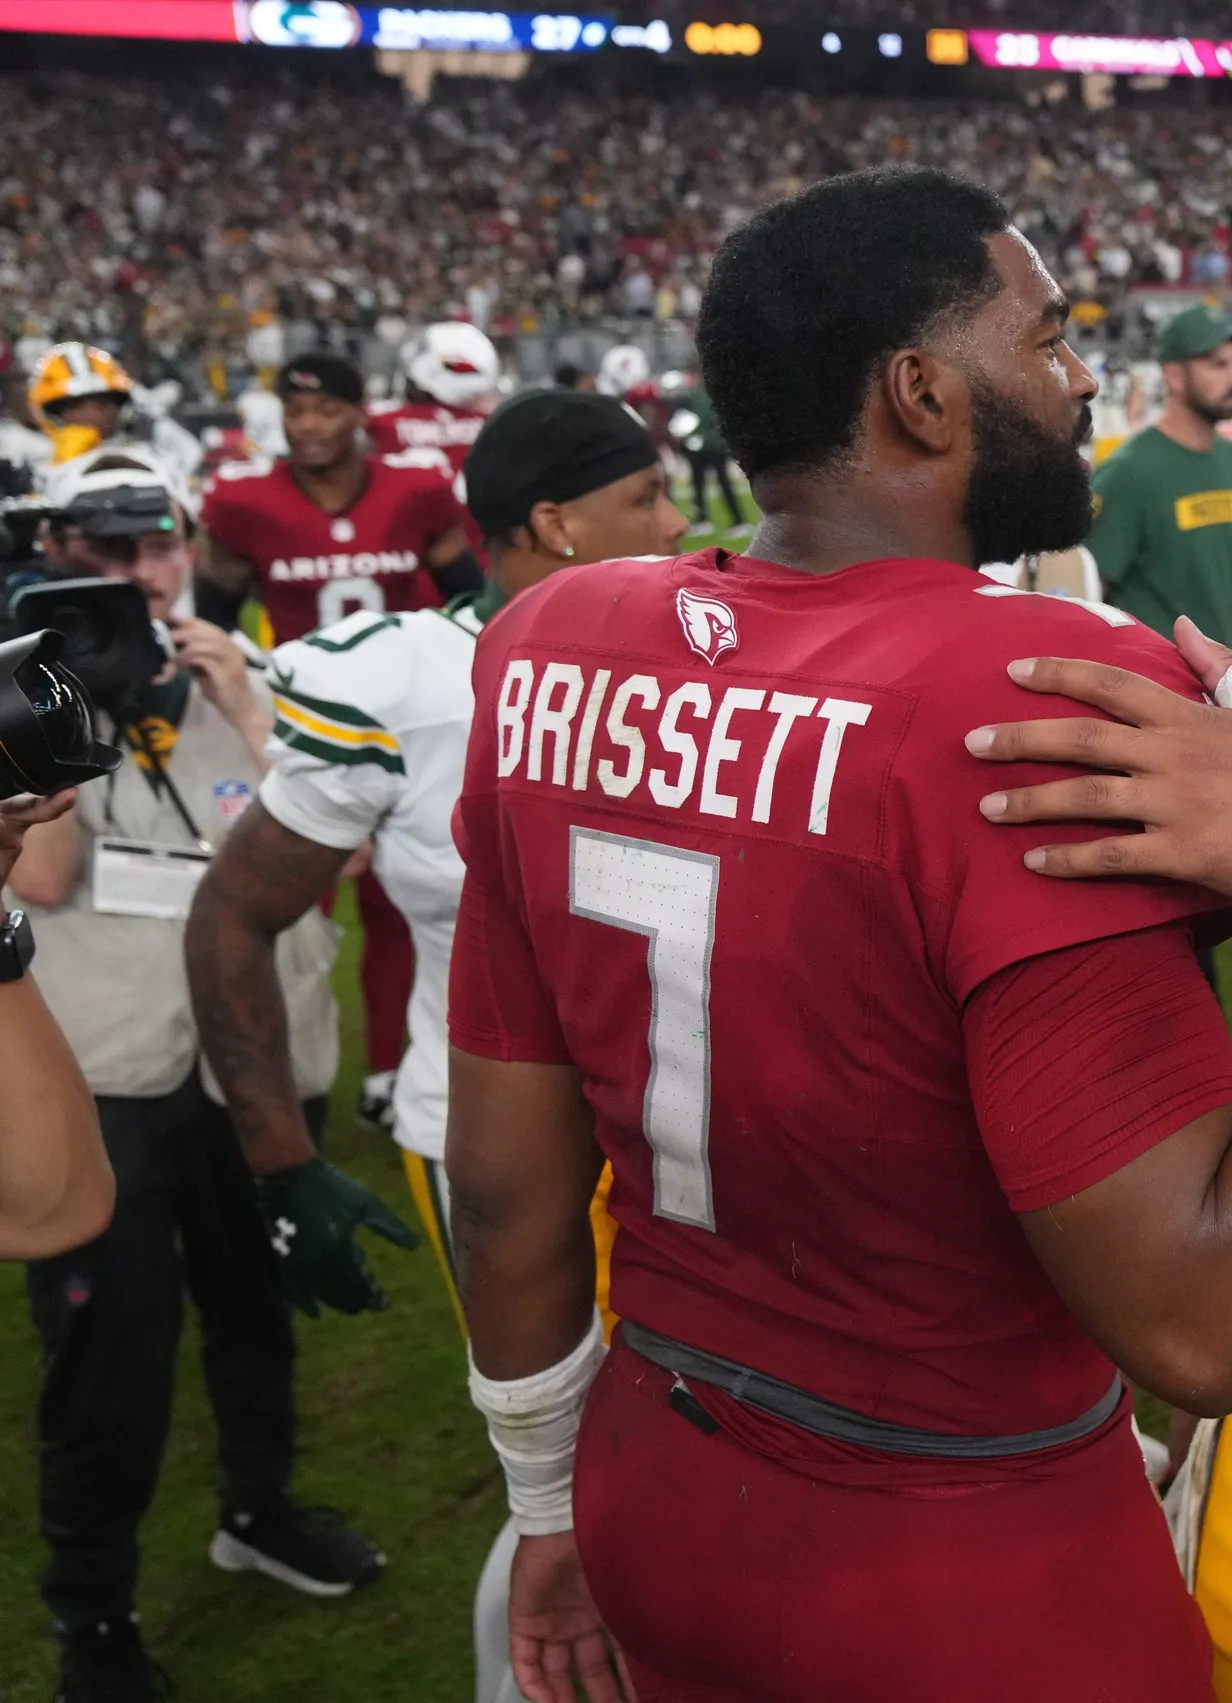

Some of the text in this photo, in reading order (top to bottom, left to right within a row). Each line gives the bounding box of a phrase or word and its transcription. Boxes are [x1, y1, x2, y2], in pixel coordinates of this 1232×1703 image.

[269, 549, 419, 581] ARIZONA
[497, 659, 872, 836] BRISSETT
[569, 826, 720, 1234] 7
